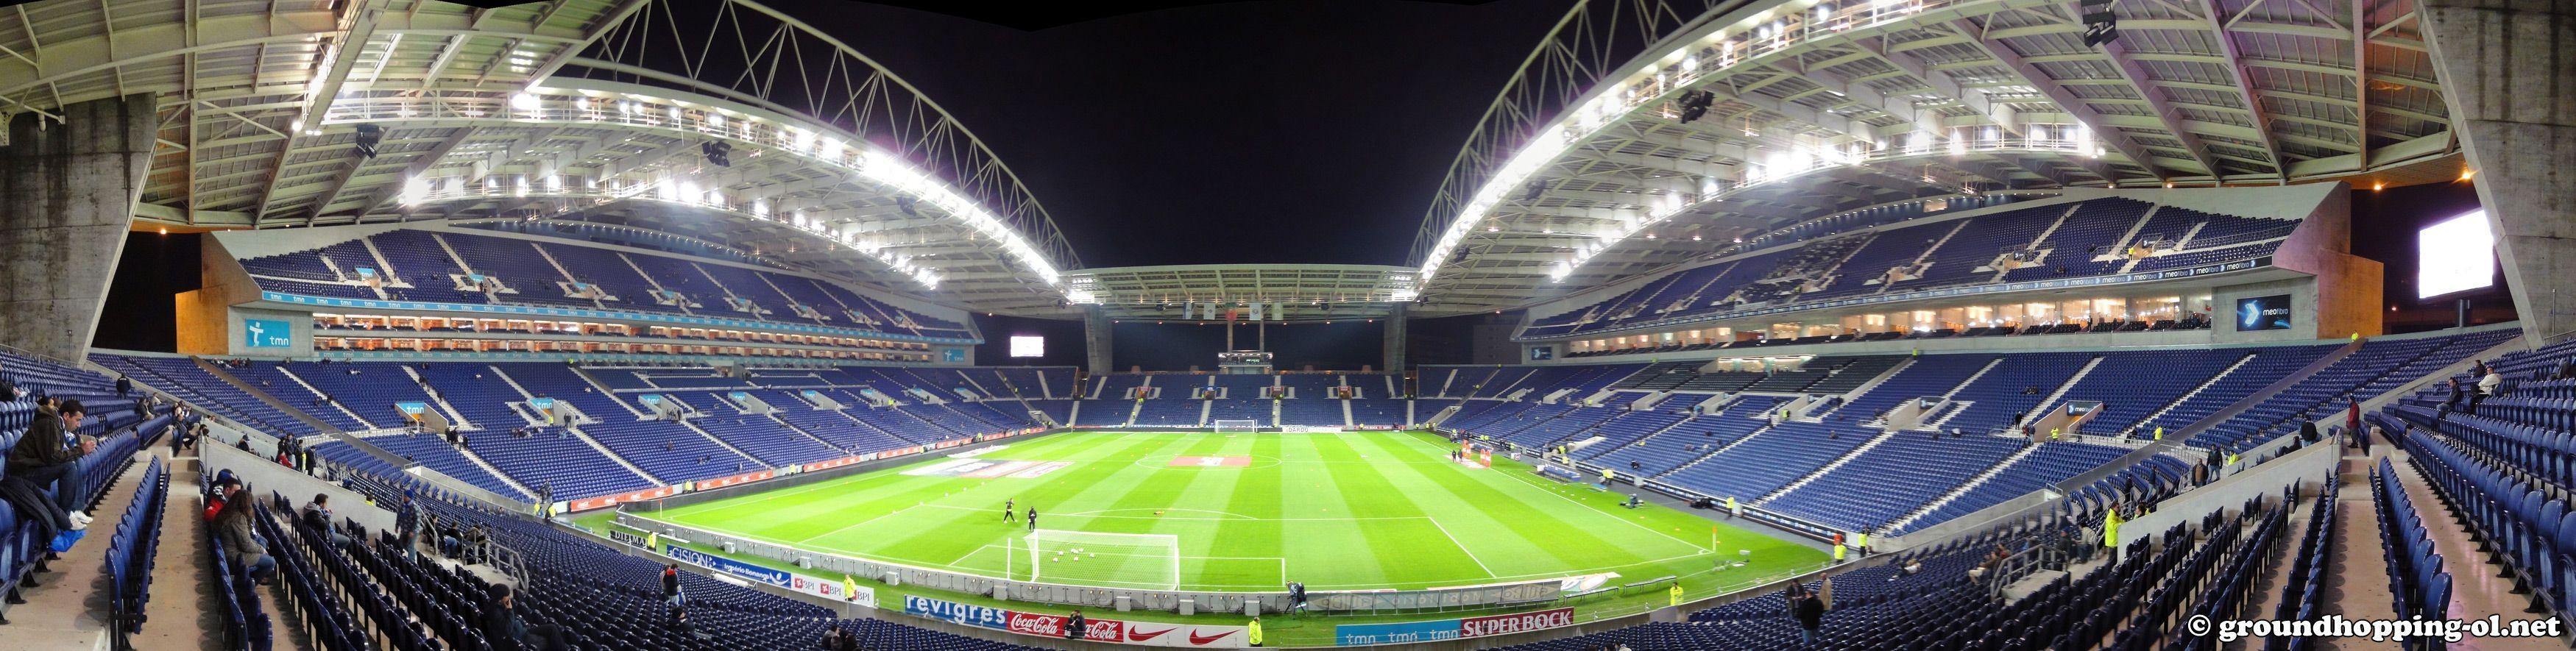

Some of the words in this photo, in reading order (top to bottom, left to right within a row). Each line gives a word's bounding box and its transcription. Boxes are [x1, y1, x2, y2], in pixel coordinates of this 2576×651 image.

[2165, 269, 2187, 278] meofibra
[2227, 262, 2249, 271] meofibra
[2262, 307, 2287, 317] meofibra
[269, 335, 289, 346] tmn
[537, 399, 552, 409] tmn
[615, 531, 648, 547] DIELMA
[803, 580, 814, 590] BPI
[829, 586, 841, 596] BPI
[857, 591, 870, 601] BPI
[1011, 613, 1059, 635] Coca-Cola
[1463, 618, 1519, 636] SUPER
[1522, 611, 1571, 630] BOCK
[1086, 621, 1119, 640] a-Cola
[1345, 634, 1376, 644] tmn
[1388, 633, 1418, 642] tmn
[1429, 630, 1458, 640] tmn
